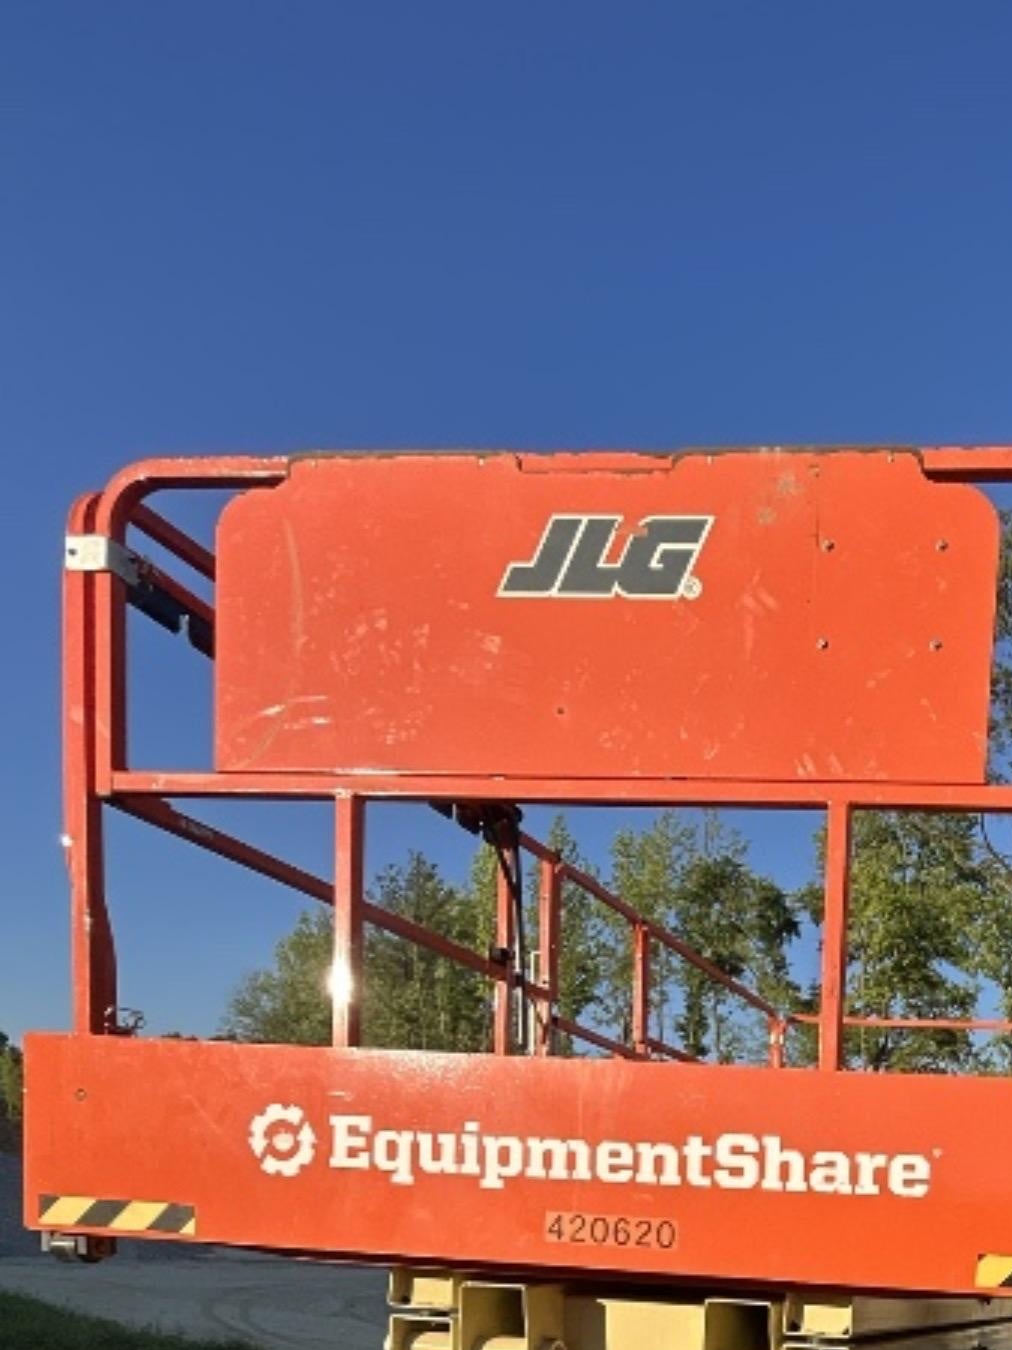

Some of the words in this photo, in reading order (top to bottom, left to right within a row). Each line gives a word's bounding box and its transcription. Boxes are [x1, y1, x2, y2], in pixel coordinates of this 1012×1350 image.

[495, 513, 716, 599] JLG
[328, 1114, 933, 1198] EquipmentShare
[548, 1214, 676, 1249] 420620
